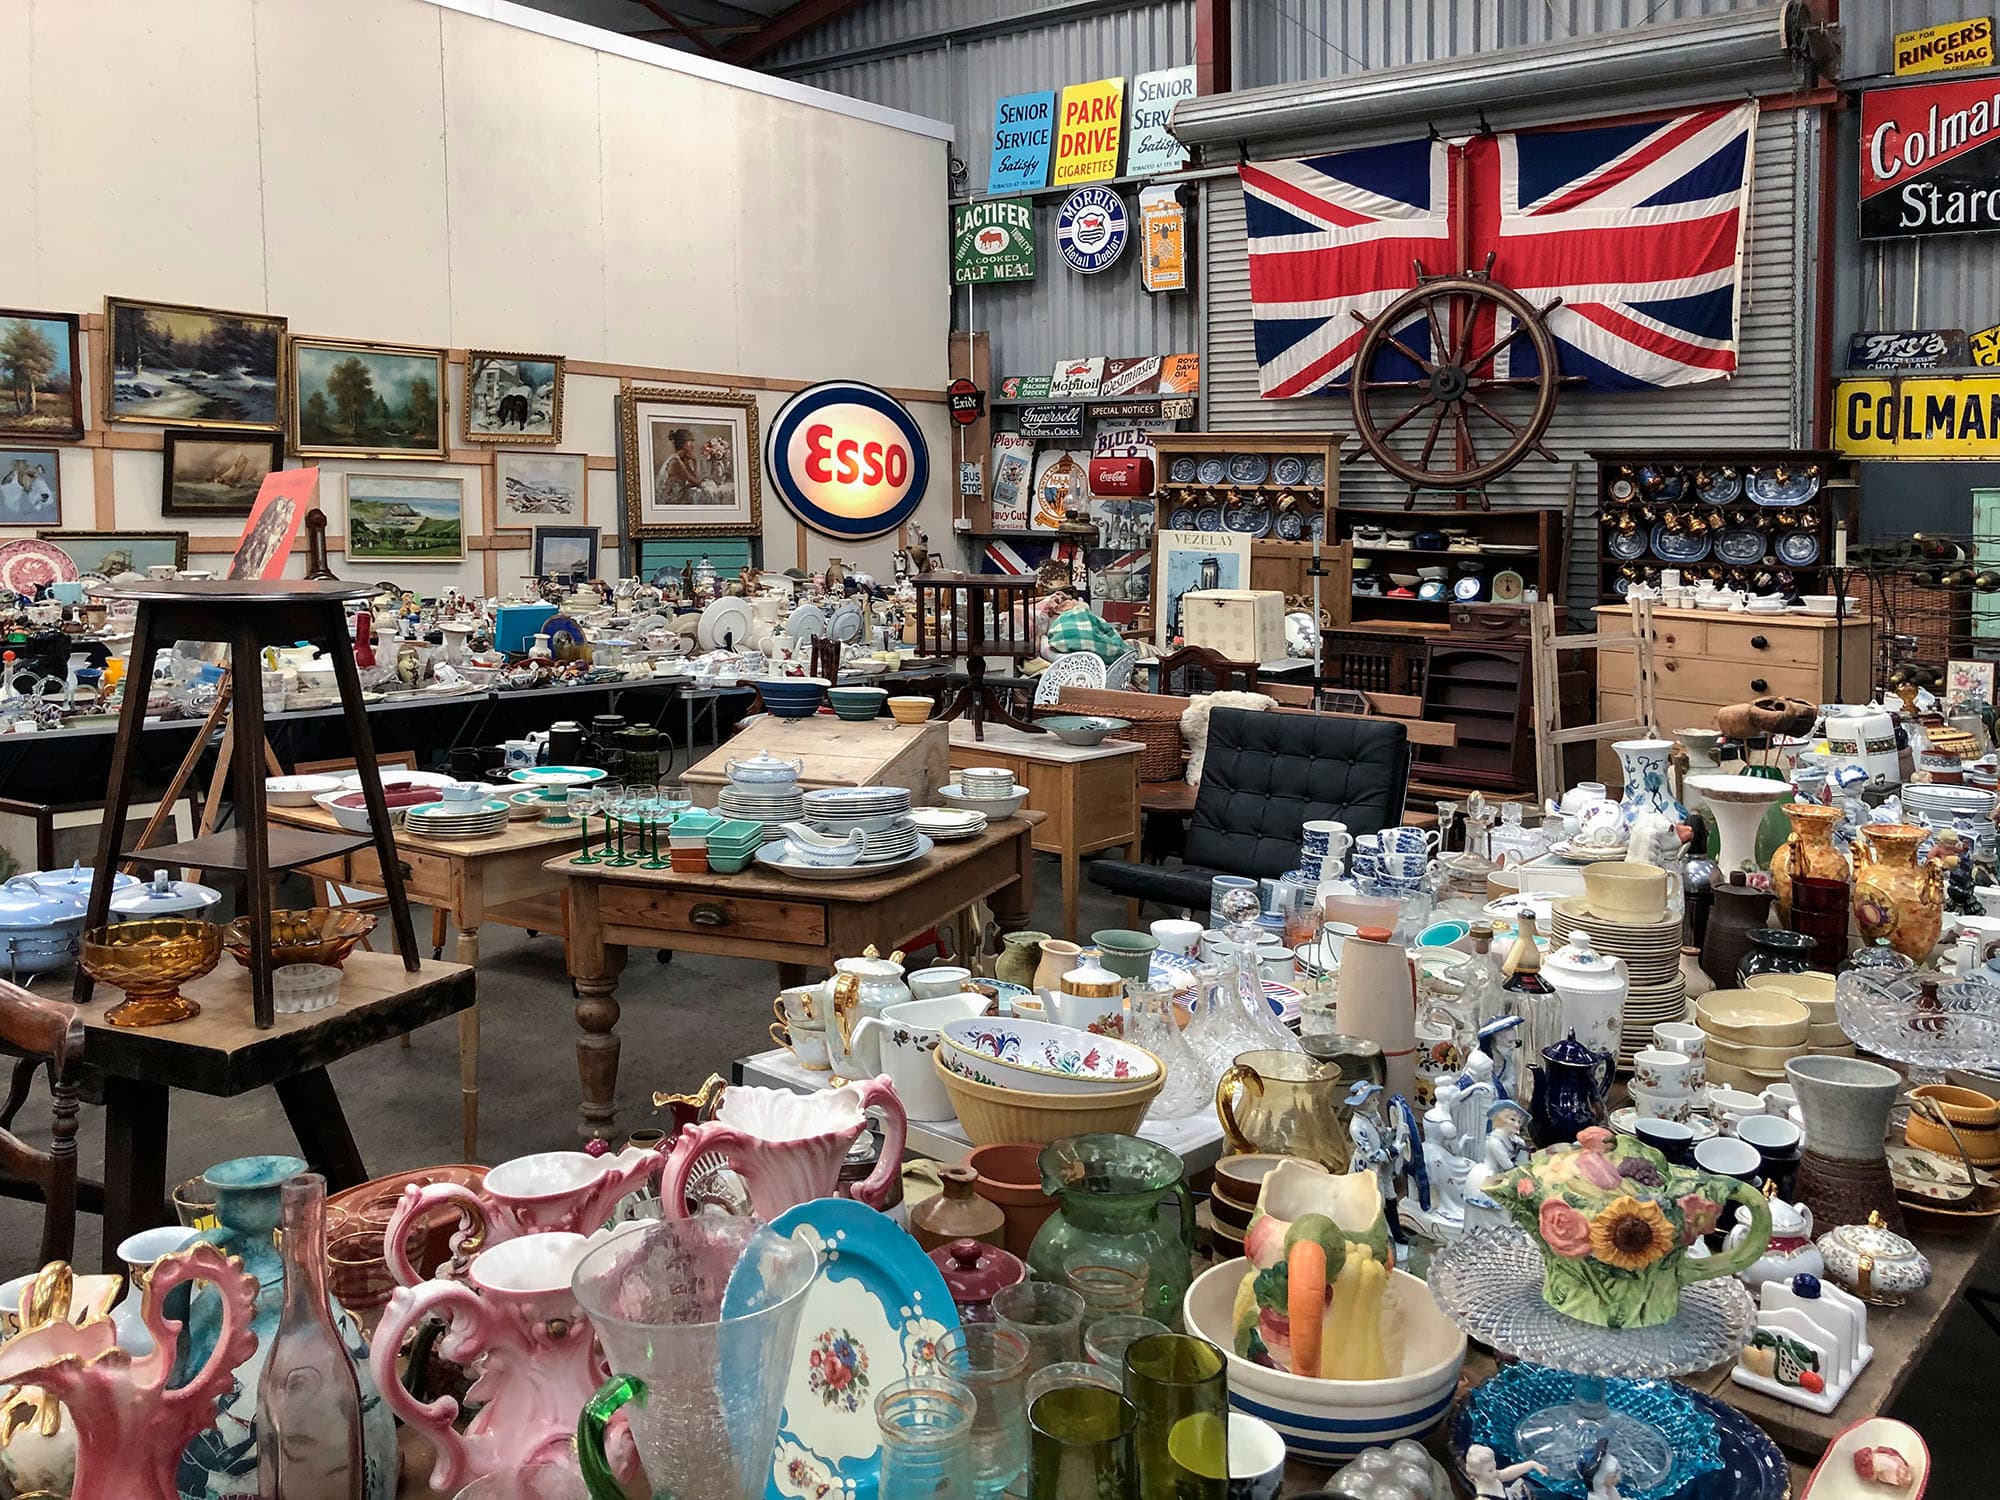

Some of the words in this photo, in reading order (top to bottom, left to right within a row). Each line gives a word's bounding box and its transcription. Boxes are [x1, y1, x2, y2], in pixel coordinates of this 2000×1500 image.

[1899, 22, 1987, 68] RINGER'S
[1900, 35, 1916, 44] ASK
[1919, 31, 1935, 39] FOR
[1943, 47, 1988, 65] SHAG
[1138, 78, 1193, 102] SENIOR
[1000, 103, 1048, 124] SENIOR
[1066, 94, 1119, 126] PARK
[995, 129, 1048, 150] SERVICE
[1060, 126, 1117, 158] DRIVE
[1138, 134, 1181, 158] Satisfy
[998, 155, 1039, 178] Satisfy
[1057, 159, 1114, 178] CIGARETTES
[1063, 190, 1117, 221] MORRIS
[956, 203, 1032, 238] LACTIFER
[975, 254, 1020, 264] COOKED
[1064, 244, 1089, 267] Retail
[1095, 235, 1120, 266] Dealer
[956, 266, 988, 282] CALF
[993, 263, 1033, 278] MEAL
[1865, 333, 1948, 360] Fry's
[1052, 378, 1100, 392] Mobiloil
[1103, 357, 1159, 396] Westminster
[953, 396, 977, 409] Exide
[1092, 406, 1119, 415] SPECIAL
[1122, 405, 1154, 415] NOTICES
[1021, 407, 1080, 424] Ingersoll
[1020, 428, 1050, 436] Watches
[1098, 430, 1134, 453] BLUE
[963, 472, 980, 481] BUS
[961, 483, 982, 493] STOP
